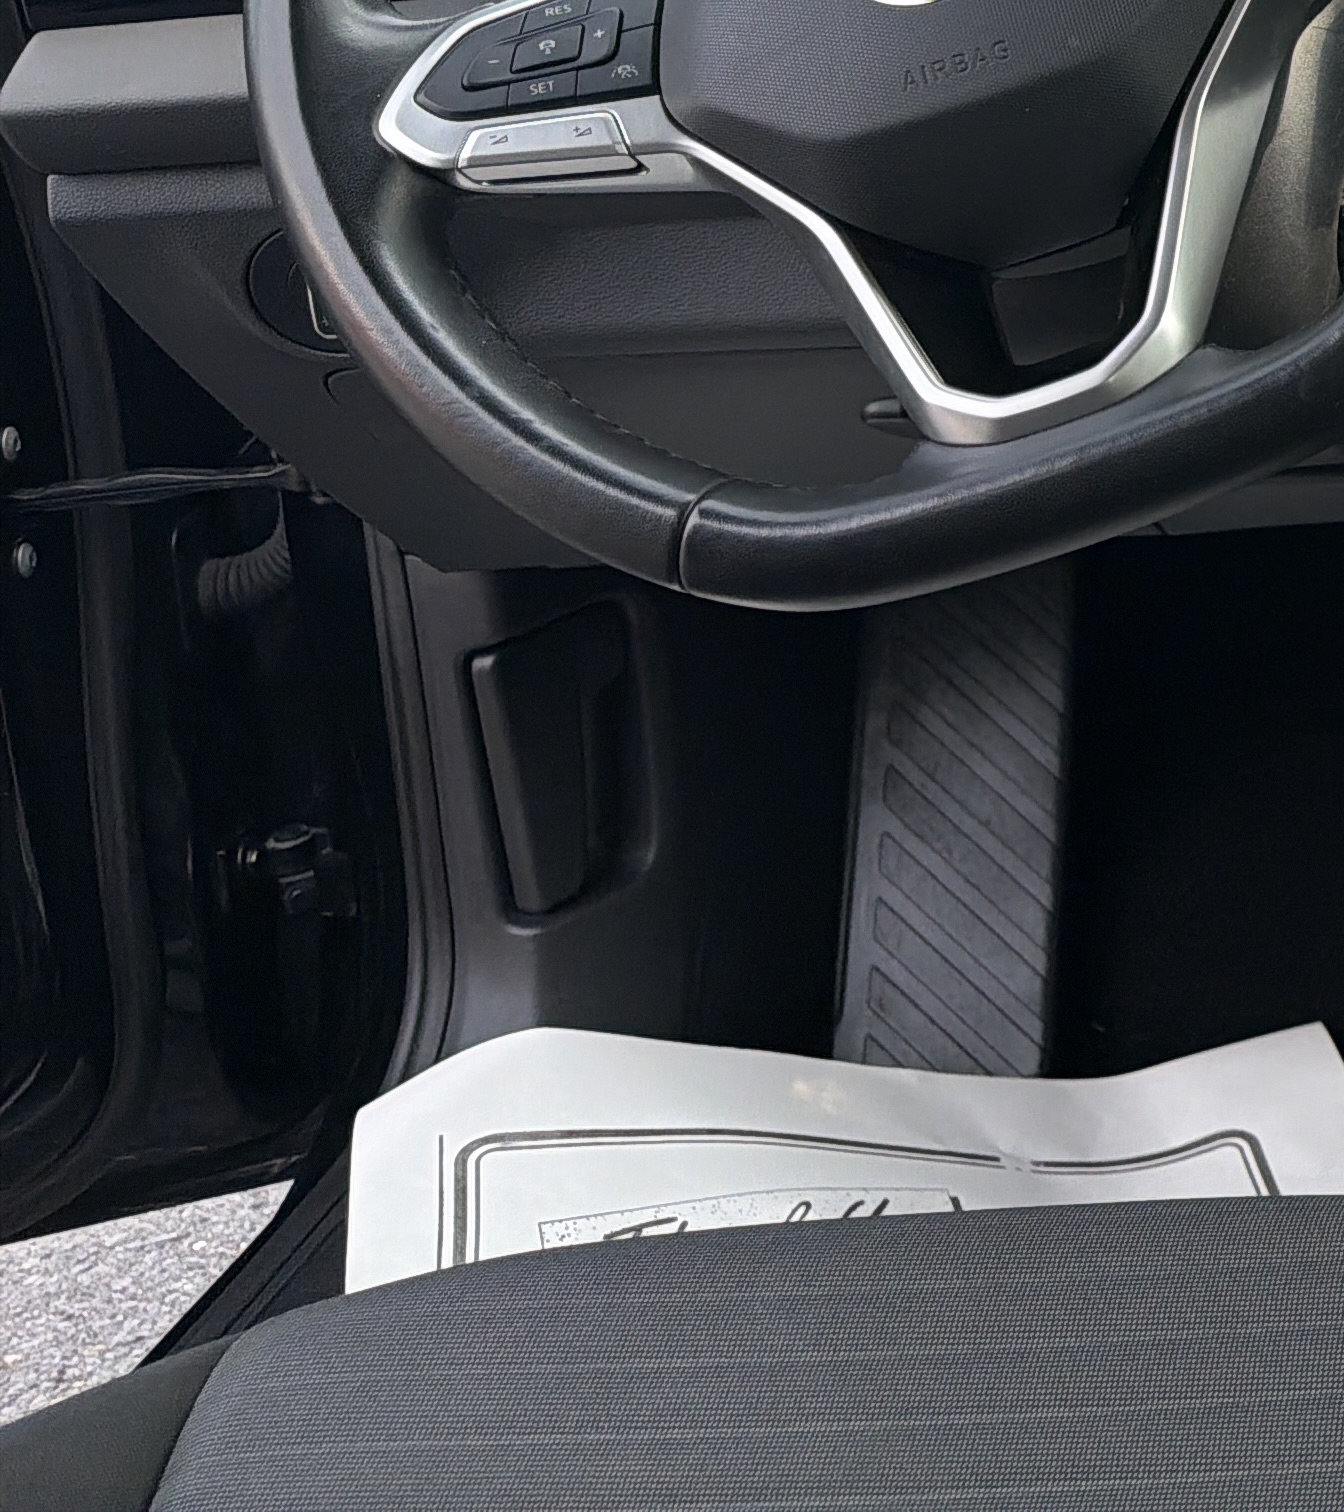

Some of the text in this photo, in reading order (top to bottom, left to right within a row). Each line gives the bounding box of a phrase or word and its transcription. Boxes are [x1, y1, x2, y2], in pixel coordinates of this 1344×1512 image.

[544, 5, 572, 17] RES
[903, 39, 1011, 90] AIRBAG
[529, 80, 555, 96] SET
